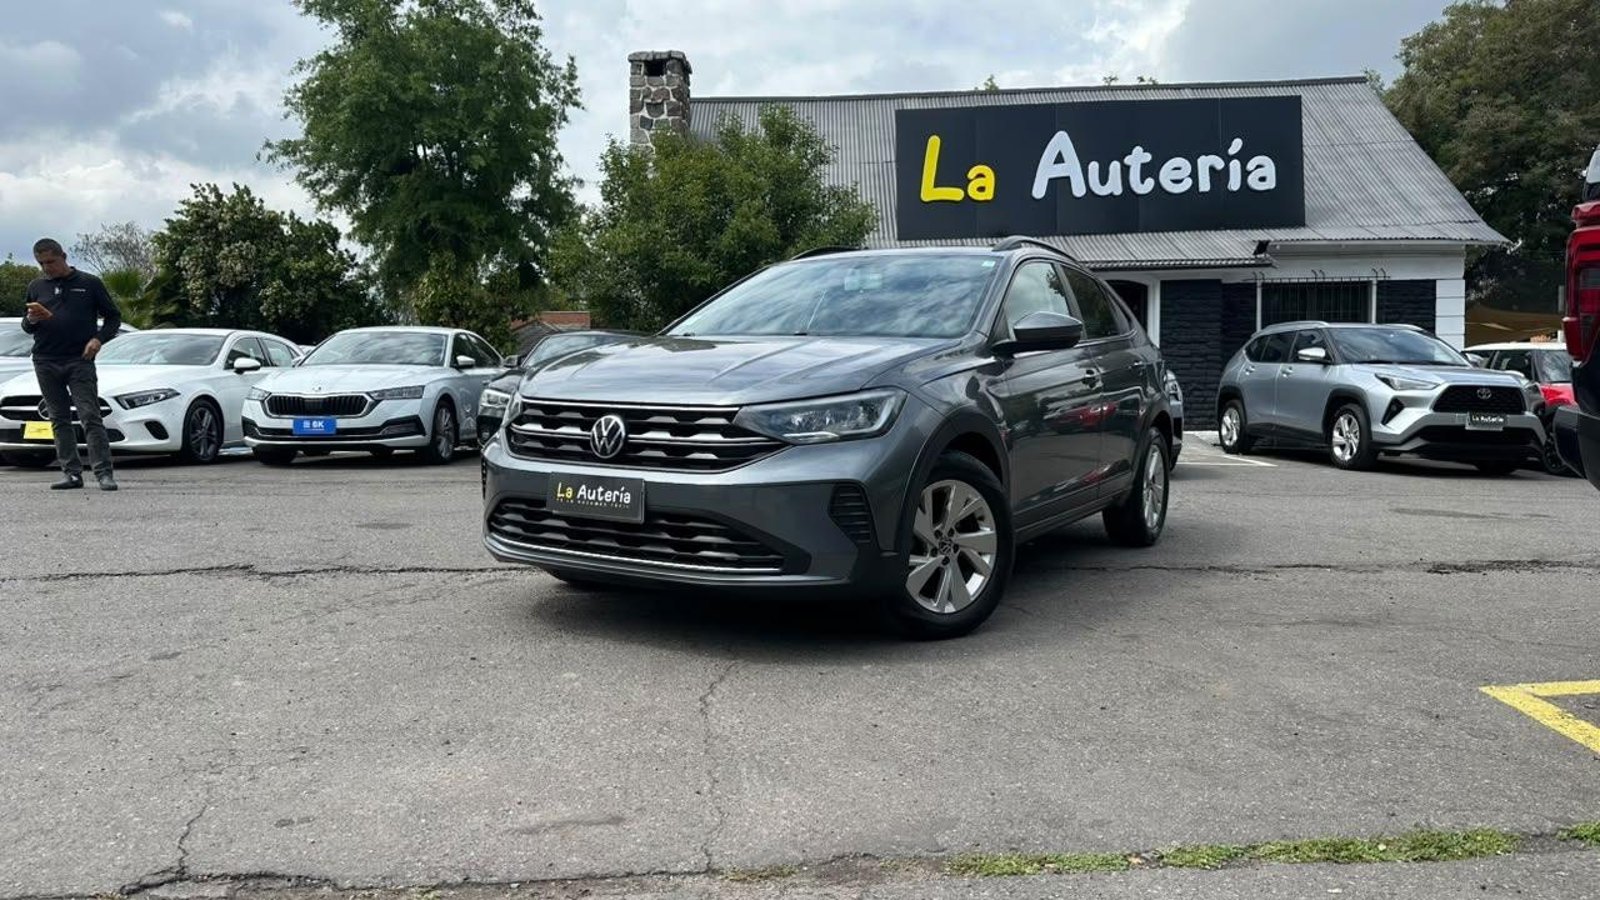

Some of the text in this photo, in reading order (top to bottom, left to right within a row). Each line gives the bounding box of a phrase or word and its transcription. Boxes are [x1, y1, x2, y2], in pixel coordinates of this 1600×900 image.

[920, 130, 1277, 203] La Autería
[556, 482, 573, 498] La
[577, 485, 631, 504] Autería
